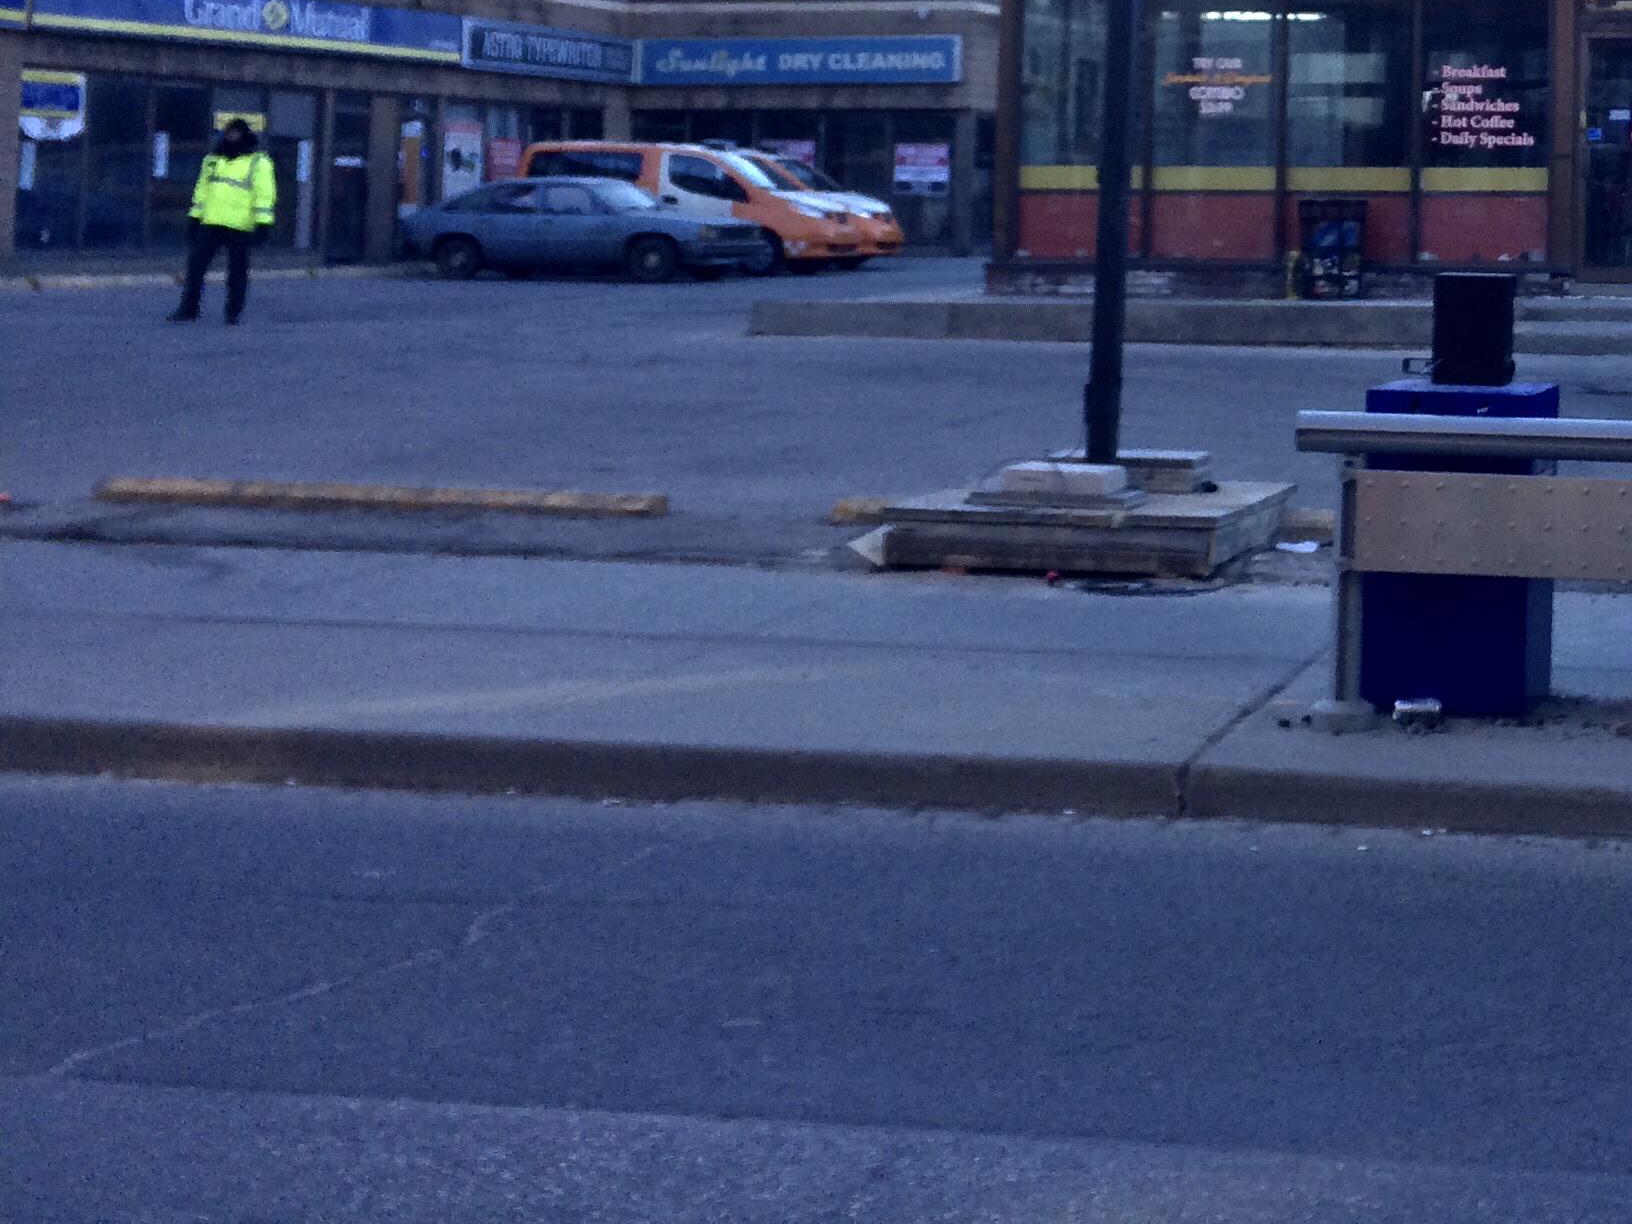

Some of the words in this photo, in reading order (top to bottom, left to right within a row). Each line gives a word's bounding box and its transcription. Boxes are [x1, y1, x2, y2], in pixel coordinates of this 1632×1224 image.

[777, 52, 823, 72] DRY
[826, 51, 946, 72] CLEANING
[1442, 64, 1507, 78] Breakfast
[1441, 81, 1483, 99] Soups
[1441, 97, 1520, 112] Sandwiches
[1441, 115, 1468, 128] Hot
[1470, 115, 1515, 128] Coffee
[1440, 131, 1478, 148] Daily
[1479, 132, 1535, 148] Specials
